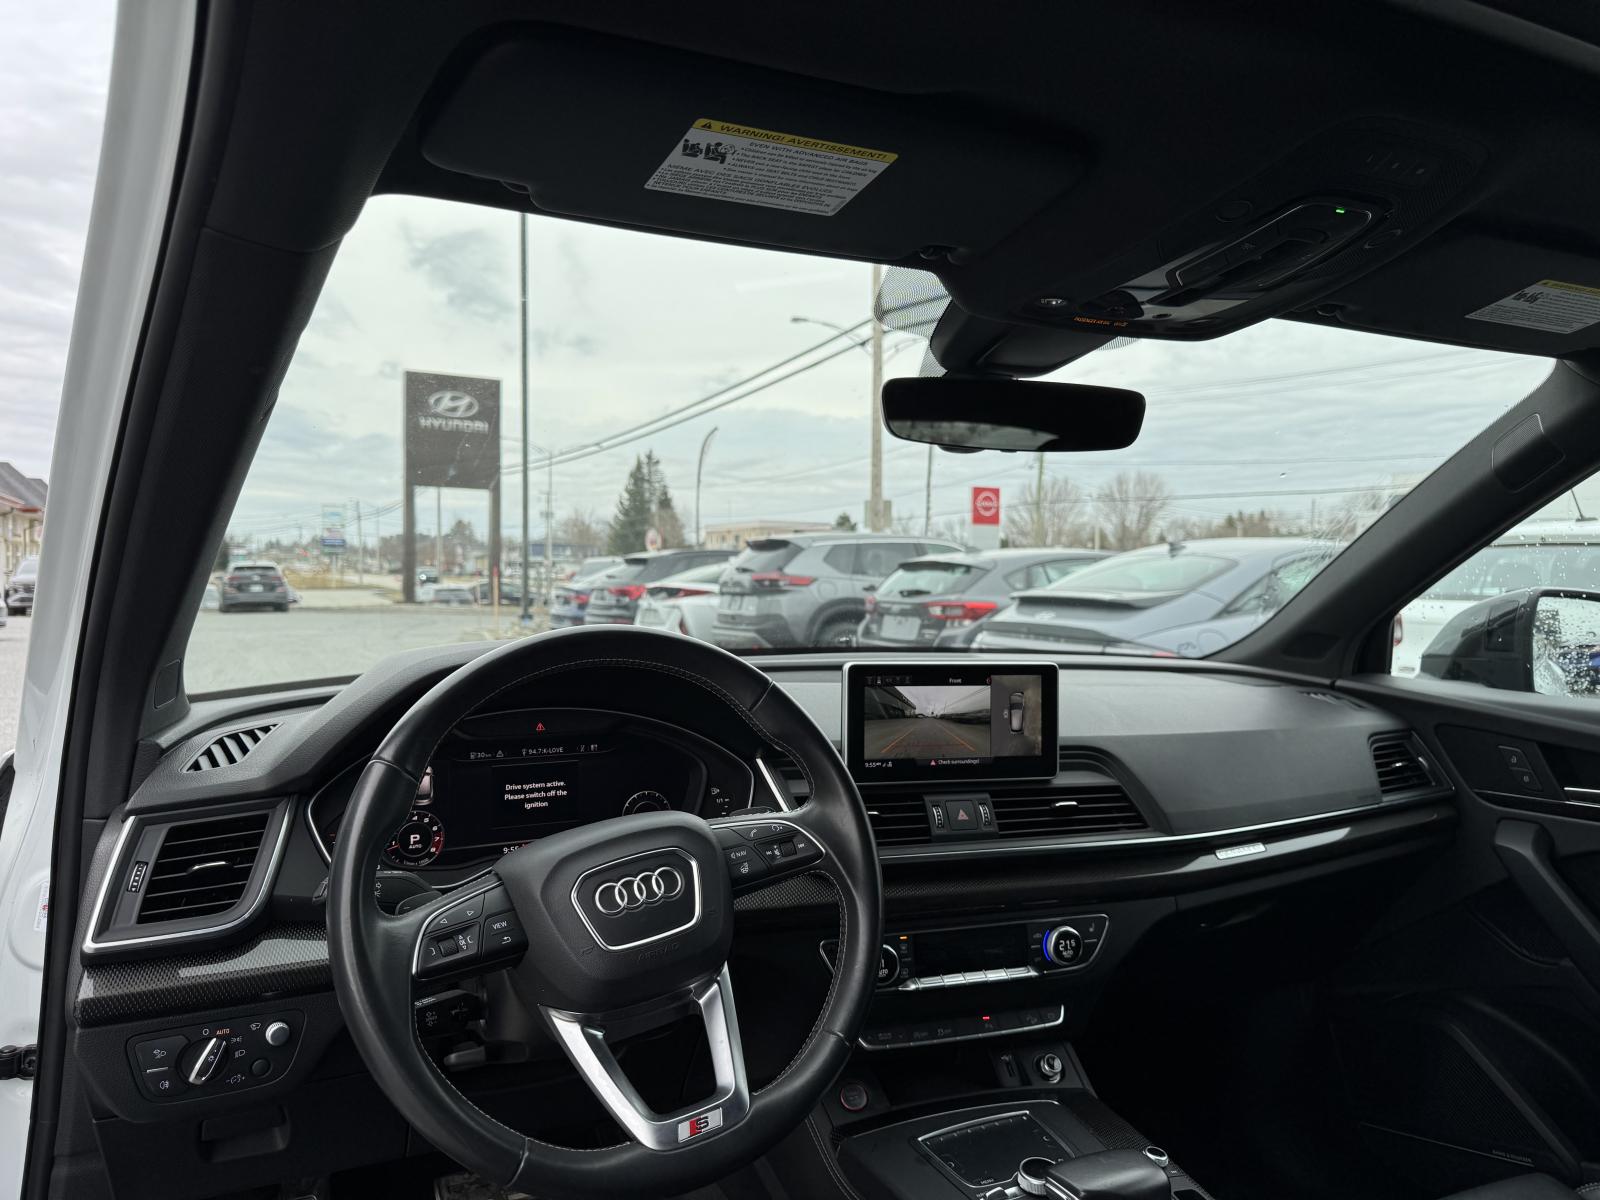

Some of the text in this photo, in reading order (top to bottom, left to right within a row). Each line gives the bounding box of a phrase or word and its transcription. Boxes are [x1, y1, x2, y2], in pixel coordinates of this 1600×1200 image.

[720, 124, 887, 159] WARNING! AVERTISSEMENT!
[770, 145, 793, 153] WITH
[792, 149, 834, 160] ADVANCED
[522, 782, 545, 791] system
[546, 780, 567, 788] active.
[504, 788, 568, 801] Please switch off the
[524, 801, 549, 810] ignition
[410, 834, 420, 845] P
[736, 849, 747, 858] NAV
[492, 920, 507, 931] VIEW
[458, 938, 466, 946] OK
[216, 1028, 230, 1036] AUTO
[695, 1116, 710, 1131] S
